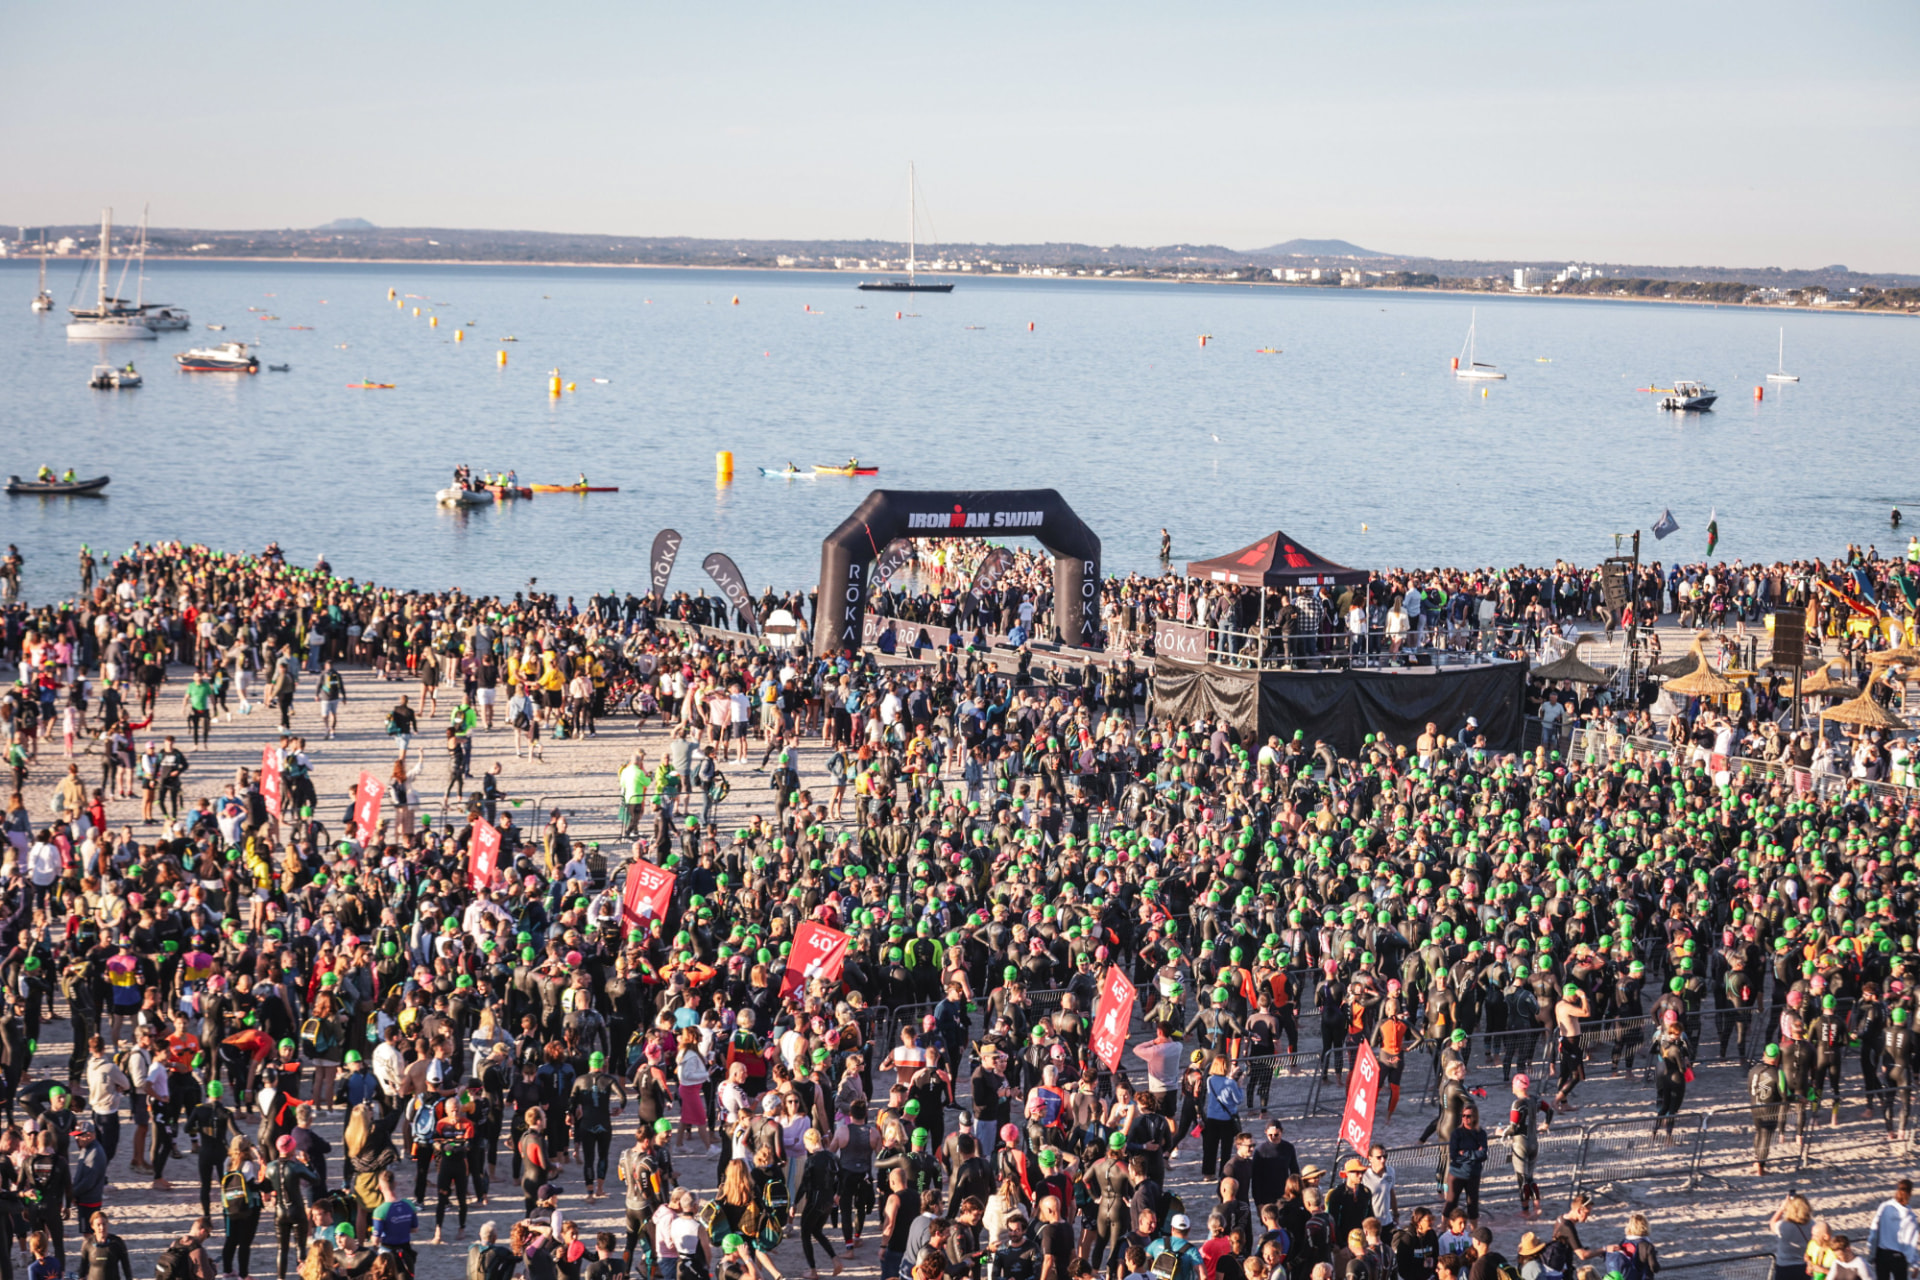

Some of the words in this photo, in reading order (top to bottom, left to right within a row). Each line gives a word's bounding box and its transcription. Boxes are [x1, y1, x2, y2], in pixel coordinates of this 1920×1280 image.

[908, 507, 990, 528] IRONMAN
[993, 511, 1043, 527] SWIM
[1298, 574, 1335, 585] IRONMAN
[639, 871, 665, 891] 35'
[1112, 980, 1128, 1003] 45'
[1096, 1036, 1118, 1058] 45'
[1360, 1058, 1375, 1083] 60'
[1347, 1119, 1365, 1143] 60'
